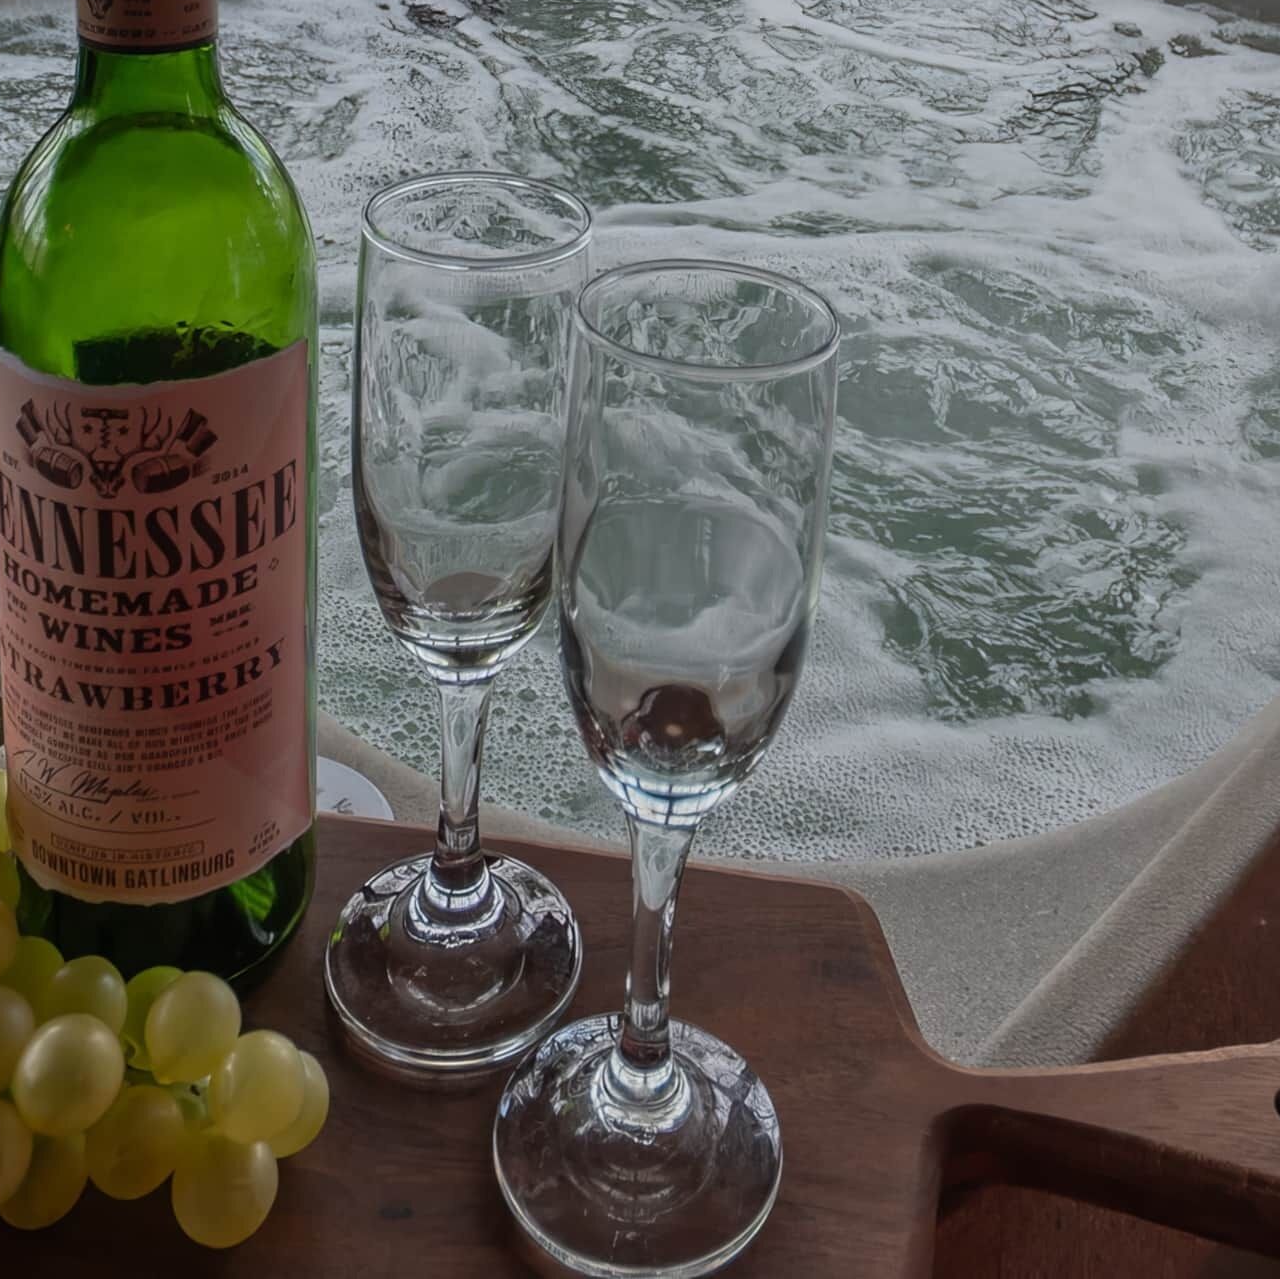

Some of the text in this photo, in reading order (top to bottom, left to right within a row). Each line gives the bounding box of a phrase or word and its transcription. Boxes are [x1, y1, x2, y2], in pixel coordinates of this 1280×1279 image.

[212, 463, 249, 485] 2014
[4, 550, 259, 617] HOMEMADE
[38, 612, 193, 654] WINES
[59, 803, 101, 822] ALC.
[32, 838, 117, 889] DOWNTOWN
[124, 848, 236, 889] GATLINBURG
